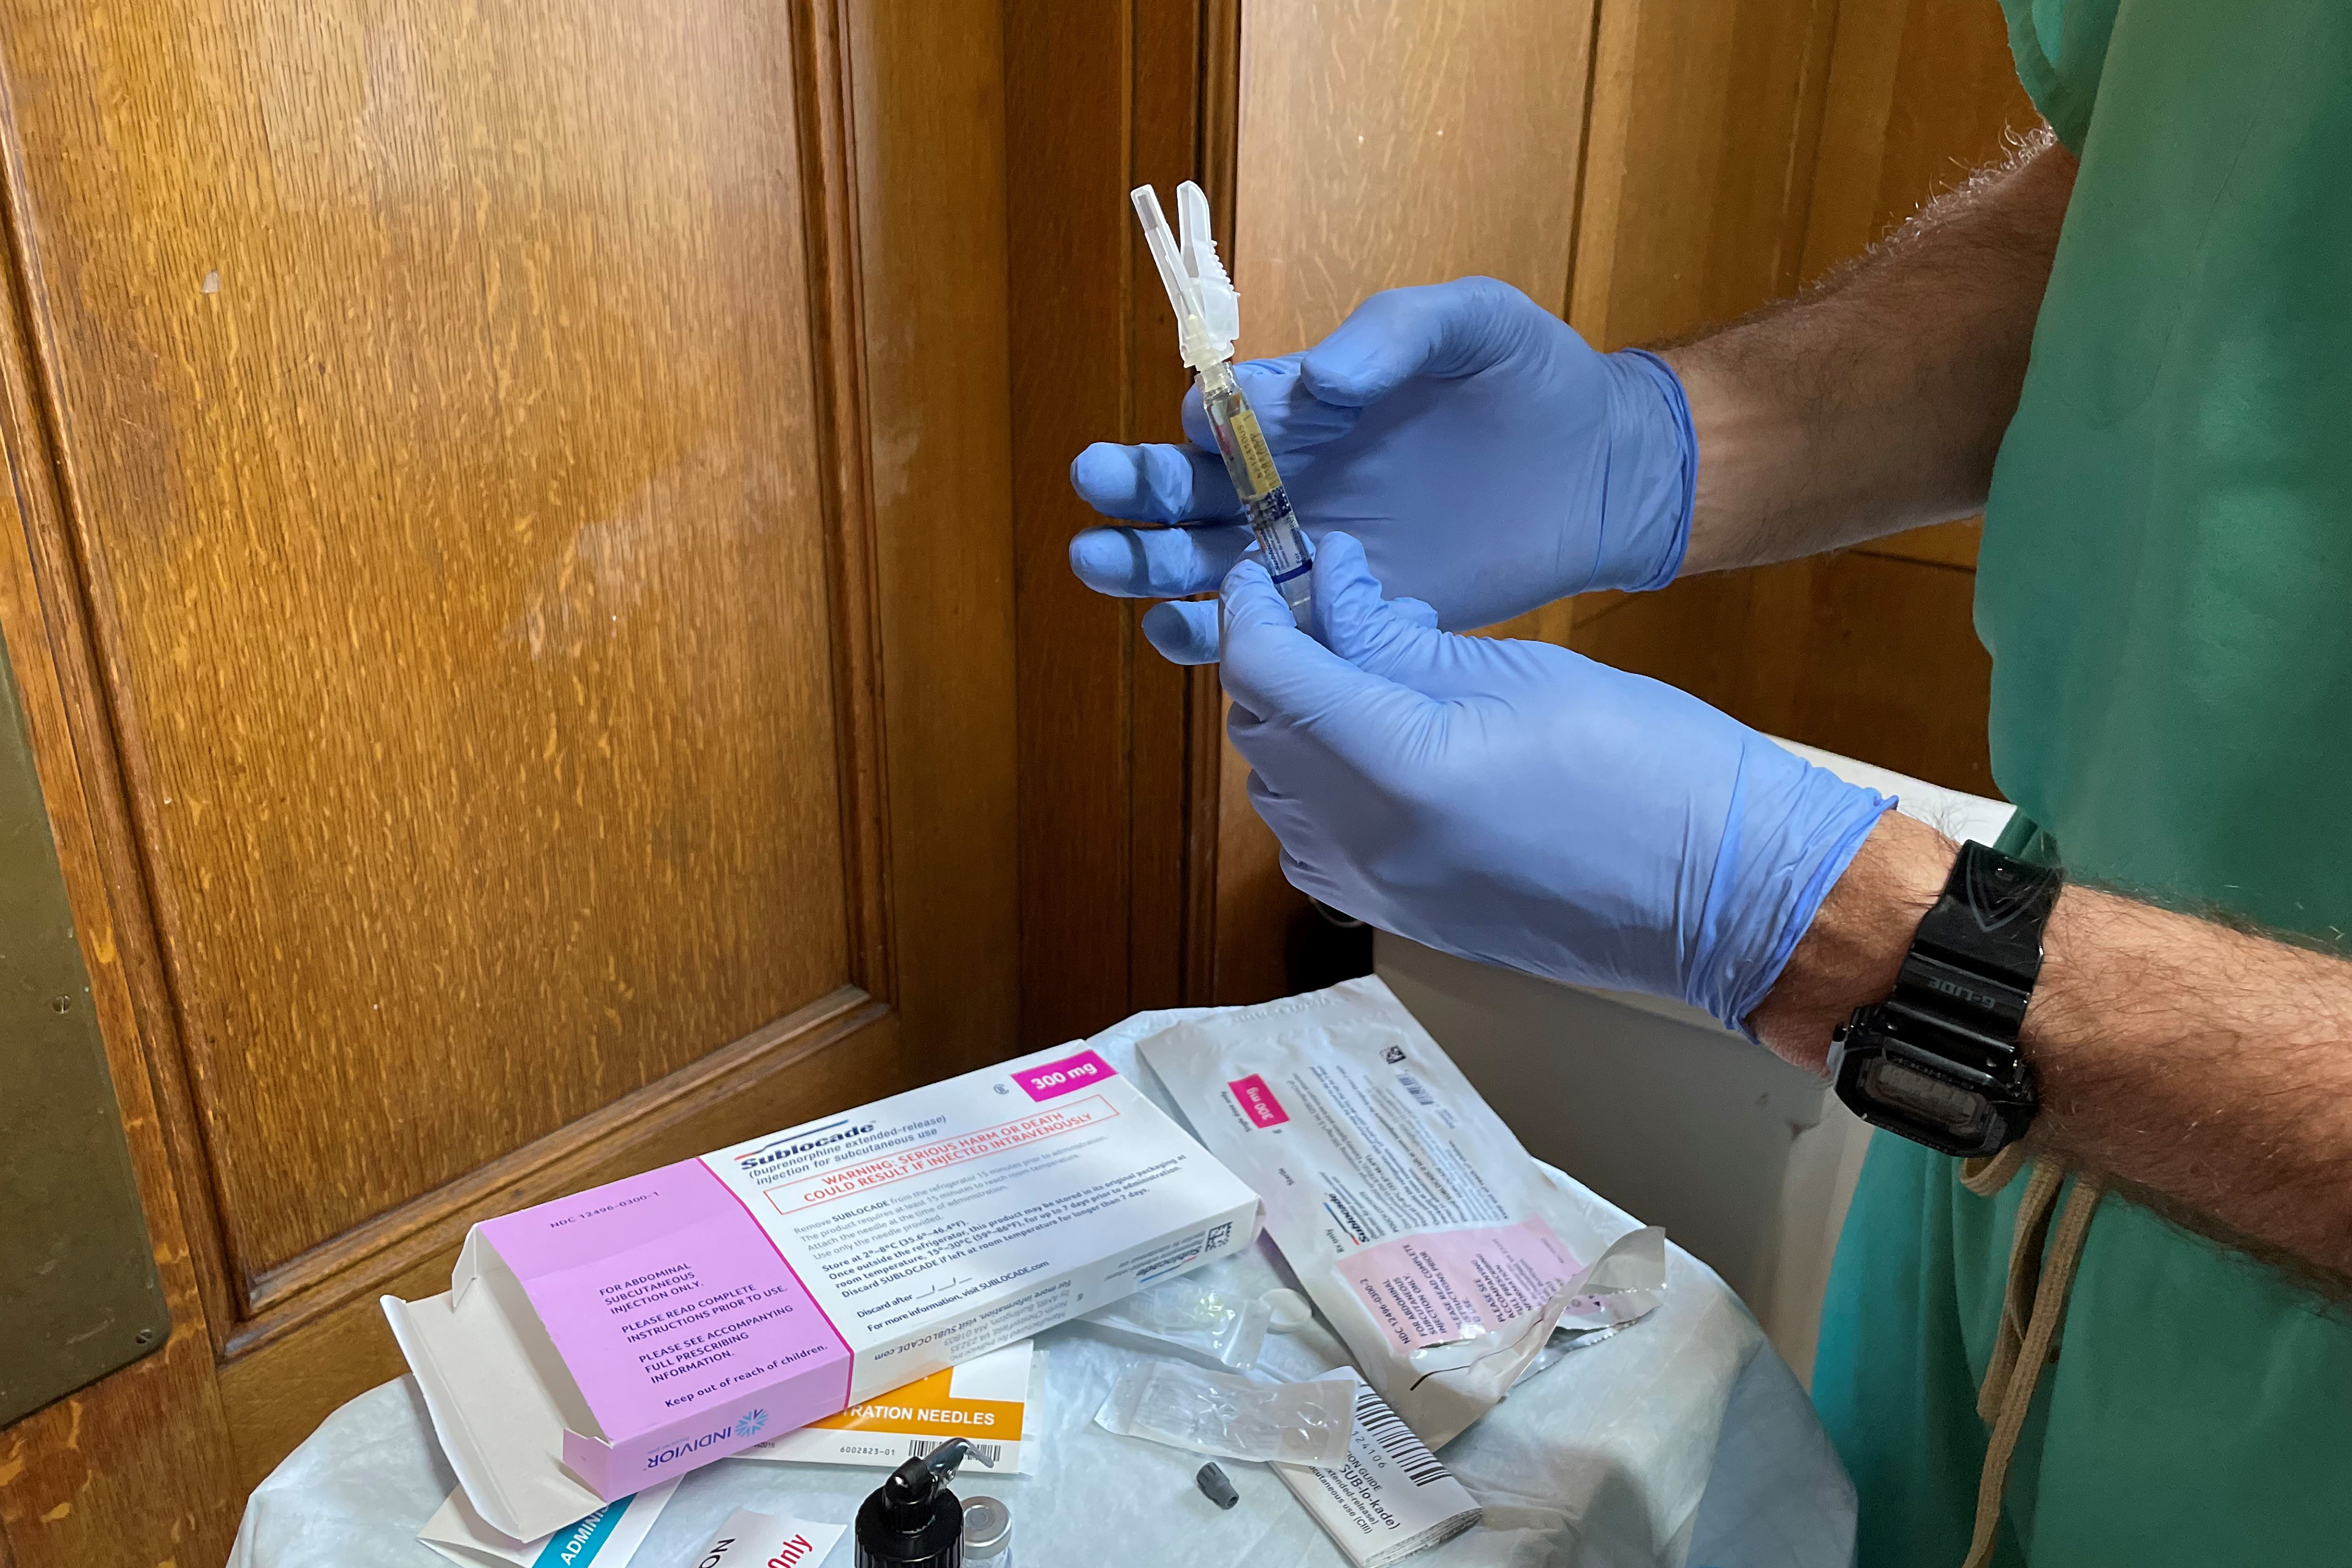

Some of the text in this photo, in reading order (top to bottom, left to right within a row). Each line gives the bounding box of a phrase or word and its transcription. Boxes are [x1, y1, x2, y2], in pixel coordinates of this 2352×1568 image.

[1030, 1063, 1098, 1089] 300 mg
[1245, 1087, 1274, 1120] 300 mg
[748, 1115, 947, 1178] (buprenorphine extended-release)
[756, 1128, 938, 1185] injection for subcutaneous use
[803, 1112, 1092, 1202] COULD RESULT IF INJECTED INTRAVENOUSLY
[821, 1112, 1064, 1185] WARNING: SERIOUS HARM OR DEATH
[549, 1191, 659, 1228] NDC 12496-0300-1
[793, 1219, 832, 1234] Remove
[831, 1200, 890, 1222] SUBLOCADE
[889, 1194, 913, 1204] from
[912, 1189, 929, 1197] the
[928, 1174, 976, 1193] refrigerator
[828, 1268, 856, 1280] Once
[856, 1254, 893, 1271] outside
[892, 1249, 911, 1258] the
[911, 1229, 970, 1252] refrigerator,
[968, 1223, 987, 1232] this
[987, 1211, 1023, 1227] product
[1022, 1205, 1042, 1214] may
[1054, 1191, 1082, 1204] stored
[1103, 1172, 1136, 1187] original
[1134, 1158, 1178, 1177] packaging
[807, 1237, 839, 1251] Attach
[839, 1232, 856, 1241] the
[856, 1222, 888, 1235] needle
[897, 1213, 915, 1222] the
[914, 1207, 936, 1217] time
[812, 1213, 944, 1260] Use only the needle provided.
[834, 1276, 863, 1289] room
[862, 1254, 928, 1279] temperature,
[1023, 1215, 1038, 1224] for
[1069, 1198, 1090, 1208] days
[1089, 1190, 1111, 1202] prior
[1118, 1166, 1183, 1190] administration.
[841, 1280, 880, 1298] Discard
[879, 1259, 940, 1284] SUBLOCADE
[947, 1251, 967, 1261] left
[978, 1238, 1003, 1250] room
[1002, 1219, 1058, 1242] temperature
[1057, 1214, 1072, 1223] for
[1071, 1204, 1100, 1218] longer
[1099, 1197, 1121, 1208] than
[1127, 1187, 1150, 1198] days.
[1324, 1228, 1344, 1253] Rx only
[598, 1262, 691, 1296] FOR ABDOMINAL
[821, 1259, 850, 1272] Store
[604, 1272, 695, 1305] SUBCUTANEOUS
[609, 1280, 704, 1314] INJECTION ONLY.
[621, 1284, 756, 1333] PLEASE READ COMPLETE
[856, 1294, 913, 1318] Discard after
[867, 1261, 1050, 1332] For more information, visit SUBLOCADE.com
[1382, 1280, 1427, 1336] FOR ABDOMINAL
[1392, 1276, 1438, 1335] SUBCUTANEOUS
[627, 1285, 788, 1343] INSTRUCTIONS PRIOR TO USE.
[638, 1305, 793, 1363] PLEASE SEE ACCOMPANYING
[874, 1279, 1071, 1361] For more information, visit SUBLOCADE.com
[1394, 1327, 1411, 1344] NDC
[1417, 1294, 1447, 1333] INJECTION
[644, 1332, 749, 1373] FULL PRESCRIBING
[650, 1349, 734, 1384] INFORMATION.
[664, 1344, 827, 1408] Keep out of reach of children.
[918, 1409, 995, 1426] NEEDLES
[646, 1426, 732, 1468] INDIVIOR
[840, 1446, 895, 1456] 6002823-01
[1358, 1467, 1382, 1491] GUIDE
[560, 1500, 608, 1566] ADMINI
[1341, 1503, 1356, 1517] use
[1352, 1516, 1373, 1534] (CIII)
